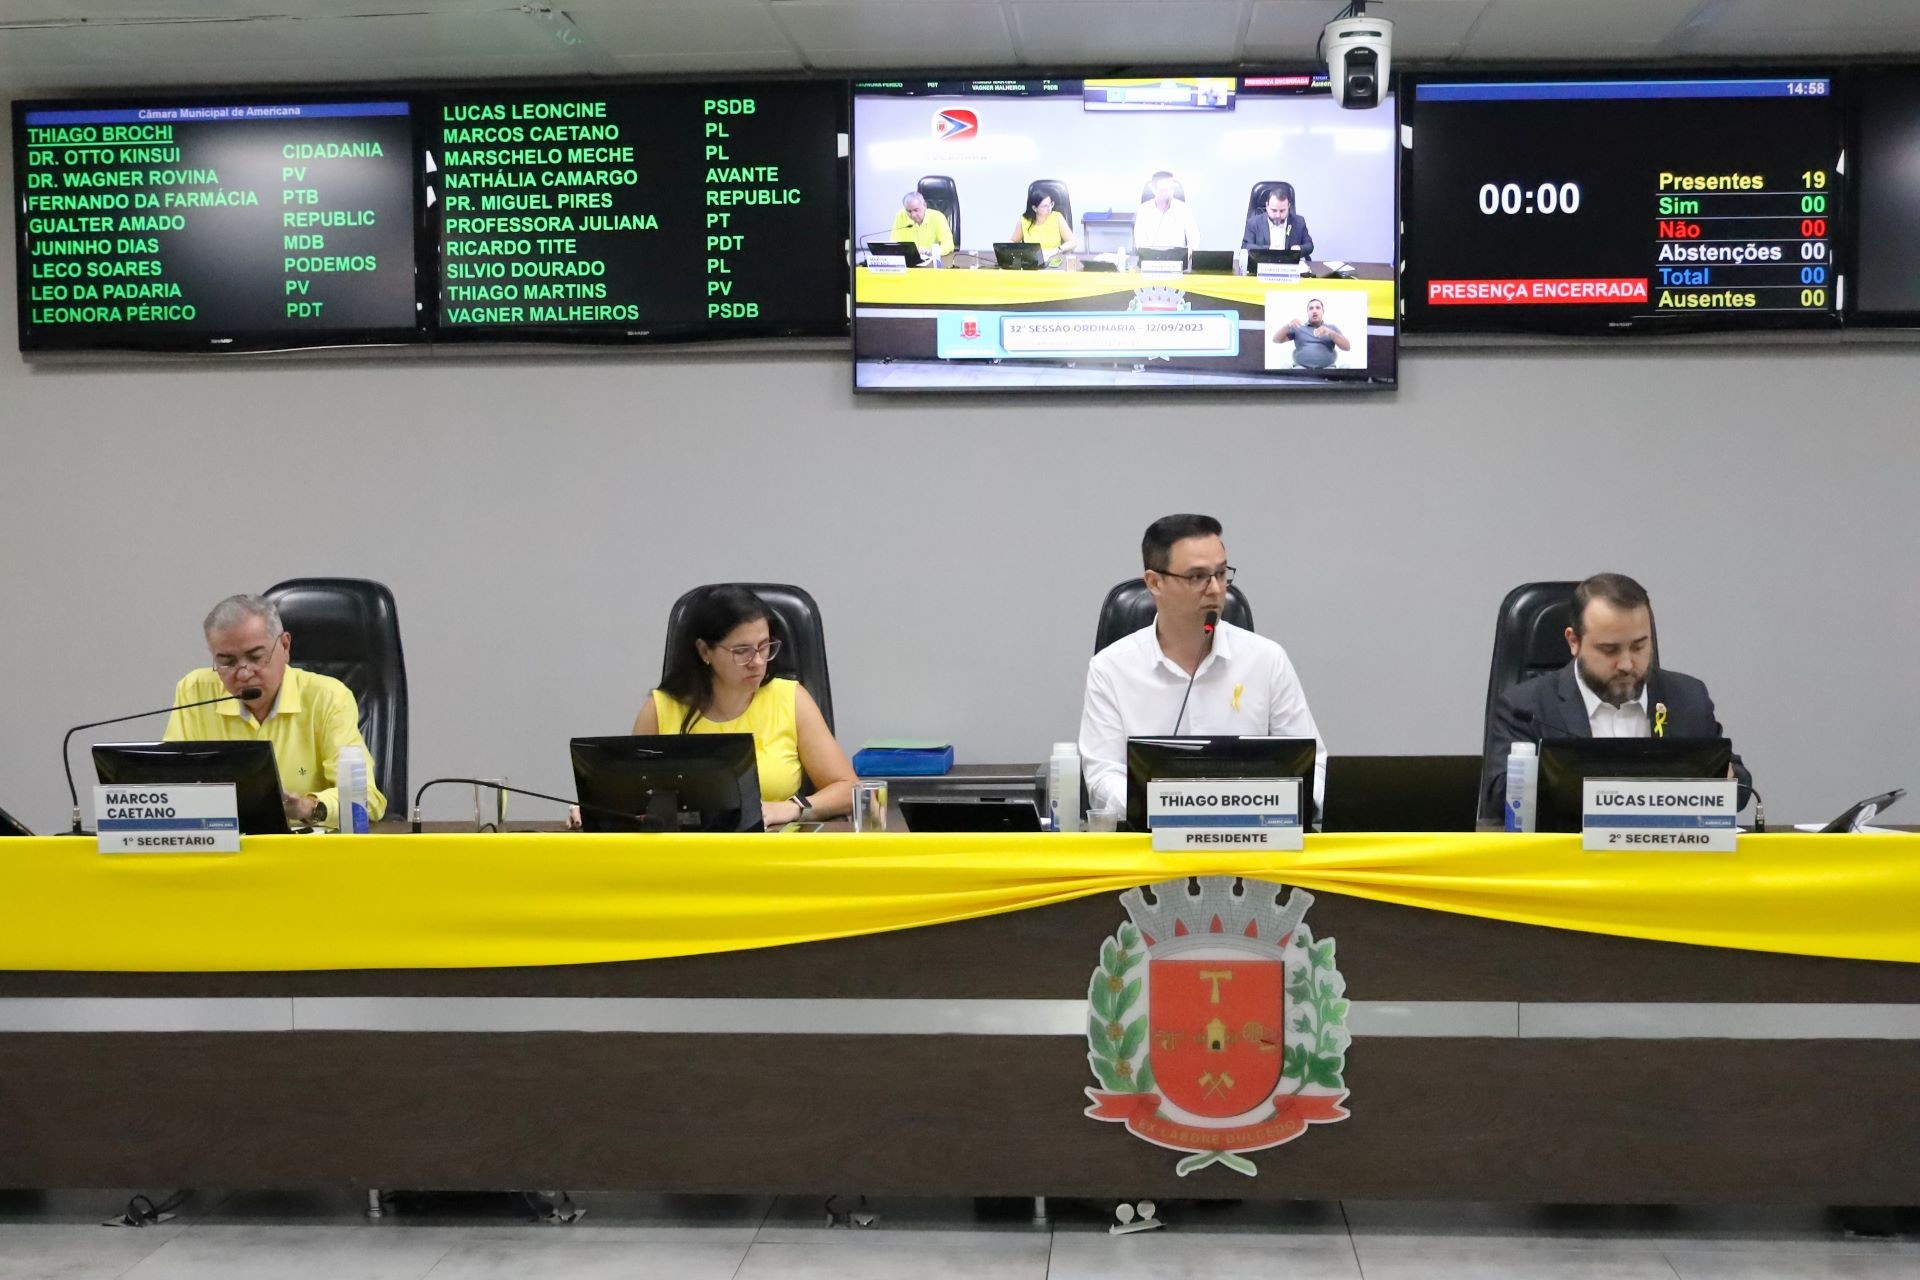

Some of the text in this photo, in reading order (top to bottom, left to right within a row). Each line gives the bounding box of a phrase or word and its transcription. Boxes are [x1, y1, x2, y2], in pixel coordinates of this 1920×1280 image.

[1785, 80, 1824, 94] 14:58
[139, 107, 301, 120] Câmara Municipal de Americana
[444, 102, 605, 121] LUCAS LEONCINE
[704, 99, 755, 114] PSDB
[29, 126, 172, 145] THIAGO BROCHI
[444, 125, 619, 143] MARCOS CAETANO
[705, 122, 728, 137] PL
[29, 147, 180, 165] DR. OTTO KINSUI
[284, 142, 384, 157] CIDADANIA
[444, 147, 632, 165] MARSCHELO MECHE
[706, 144, 728, 160] PL
[28, 170, 218, 188] DR. WAGNER ROVINA
[282, 167, 305, 181] PV
[446, 169, 638, 188] NATHÁLIA CAMARGO
[706, 167, 776, 182] AVANTE
[1660, 171, 1825, 190] Presentes 19
[29, 188, 258, 210] FERNANDO DA FARMÁCIA
[283, 188, 319, 204] PTB
[446, 192, 612, 211] PR. MIGUEL PIRES
[706, 189, 800, 205] REPUBLIC
[1479, 183, 1579, 214] 00:00
[1660, 195, 1826, 214] Sim 00
[29, 216, 184, 233] GUALTER AMADO
[284, 210, 375, 227] REPUBLIC
[445, 214, 658, 233] PROFESSORA JULIANA
[706, 213, 729, 227] PT
[1660, 220, 1826, 239] Não 00
[33, 238, 159, 256] JUNINHO DIAS
[284, 235, 324, 249] MDB
[446, 239, 577, 255] RICARDO TITE
[707, 235, 743, 251] PDT
[1659, 242, 1825, 263] Abstenções 00
[33, 261, 162, 278] LECO SOARES
[284, 256, 376, 272] PODEMOS
[448, 261, 605, 278] SILVIO DOURADO
[707, 259, 731, 273] PL
[1660, 267, 1825, 285] Total 00
[32, 283, 181, 300] LEO DA PADARIA
[285, 280, 309, 294] PV
[448, 283, 607, 300] THIAGO MARTINS
[707, 280, 732, 295] PV
[1431, 283, 1646, 300] PRESENÇA ENCERRADA
[1659, 289, 1824, 307] Ausentes 00
[33, 302, 195, 323] LEONORA PÉRICO
[286, 302, 321, 317] PDT
[448, 305, 639, 322] VAGNER MALHEIROS
[708, 303, 759, 318] PSDB
[1147, 323, 1203, 331] 12/09/2023
[107, 793, 168, 804] MARCOS
[1160, 795, 1278, 806] THIAGO BROCHI
[1596, 795, 1724, 806] LUCAS LEONCINE
[107, 808, 175, 818] CAETANO
[122, 834, 215, 846] 1º SECRETÁRIO
[1187, 834, 1267, 842] PRESIDENTE
[1609, 834, 1709, 843] 2º SECRETÁRIO
